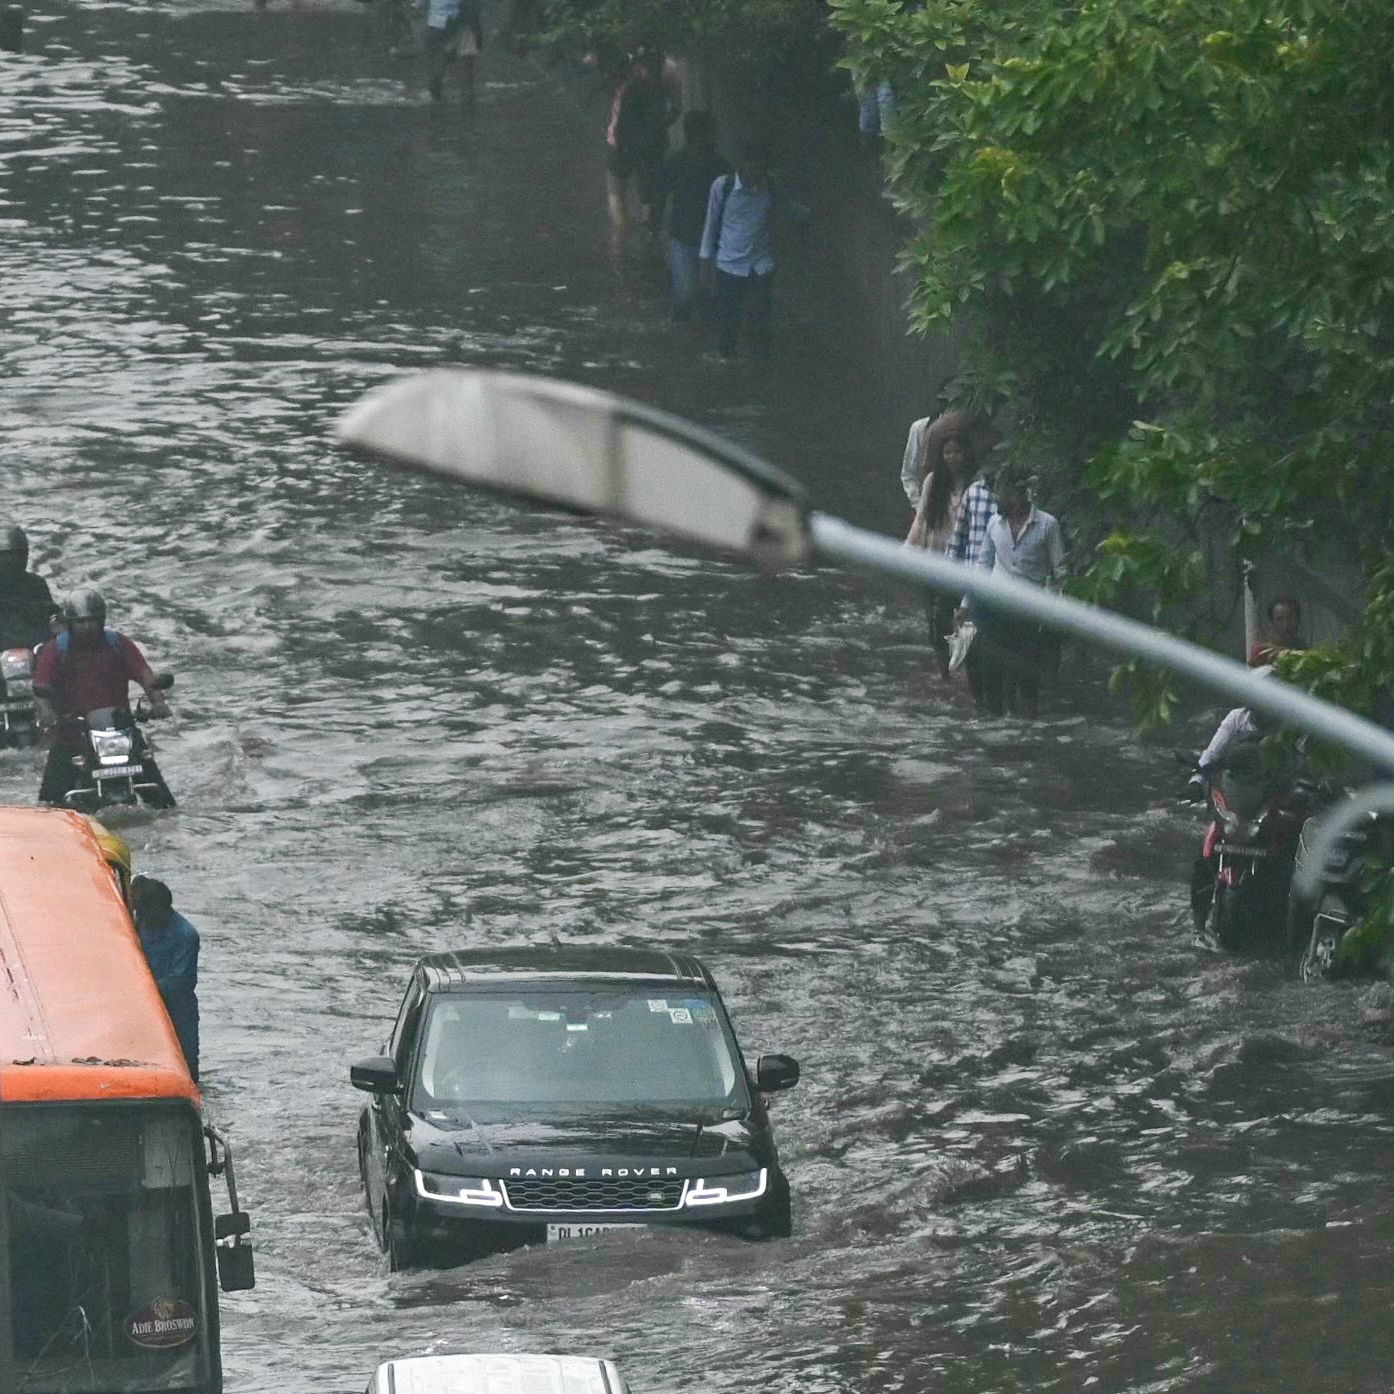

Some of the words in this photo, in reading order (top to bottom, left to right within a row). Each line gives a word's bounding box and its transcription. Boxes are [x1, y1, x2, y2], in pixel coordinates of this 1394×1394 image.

[509, 1167, 586, 1177] RANGE
[601, 1166, 678, 1177] ROVER
[132, 1321, 154, 1334] ADIE
[154, 1317, 195, 1333] BROSWON
